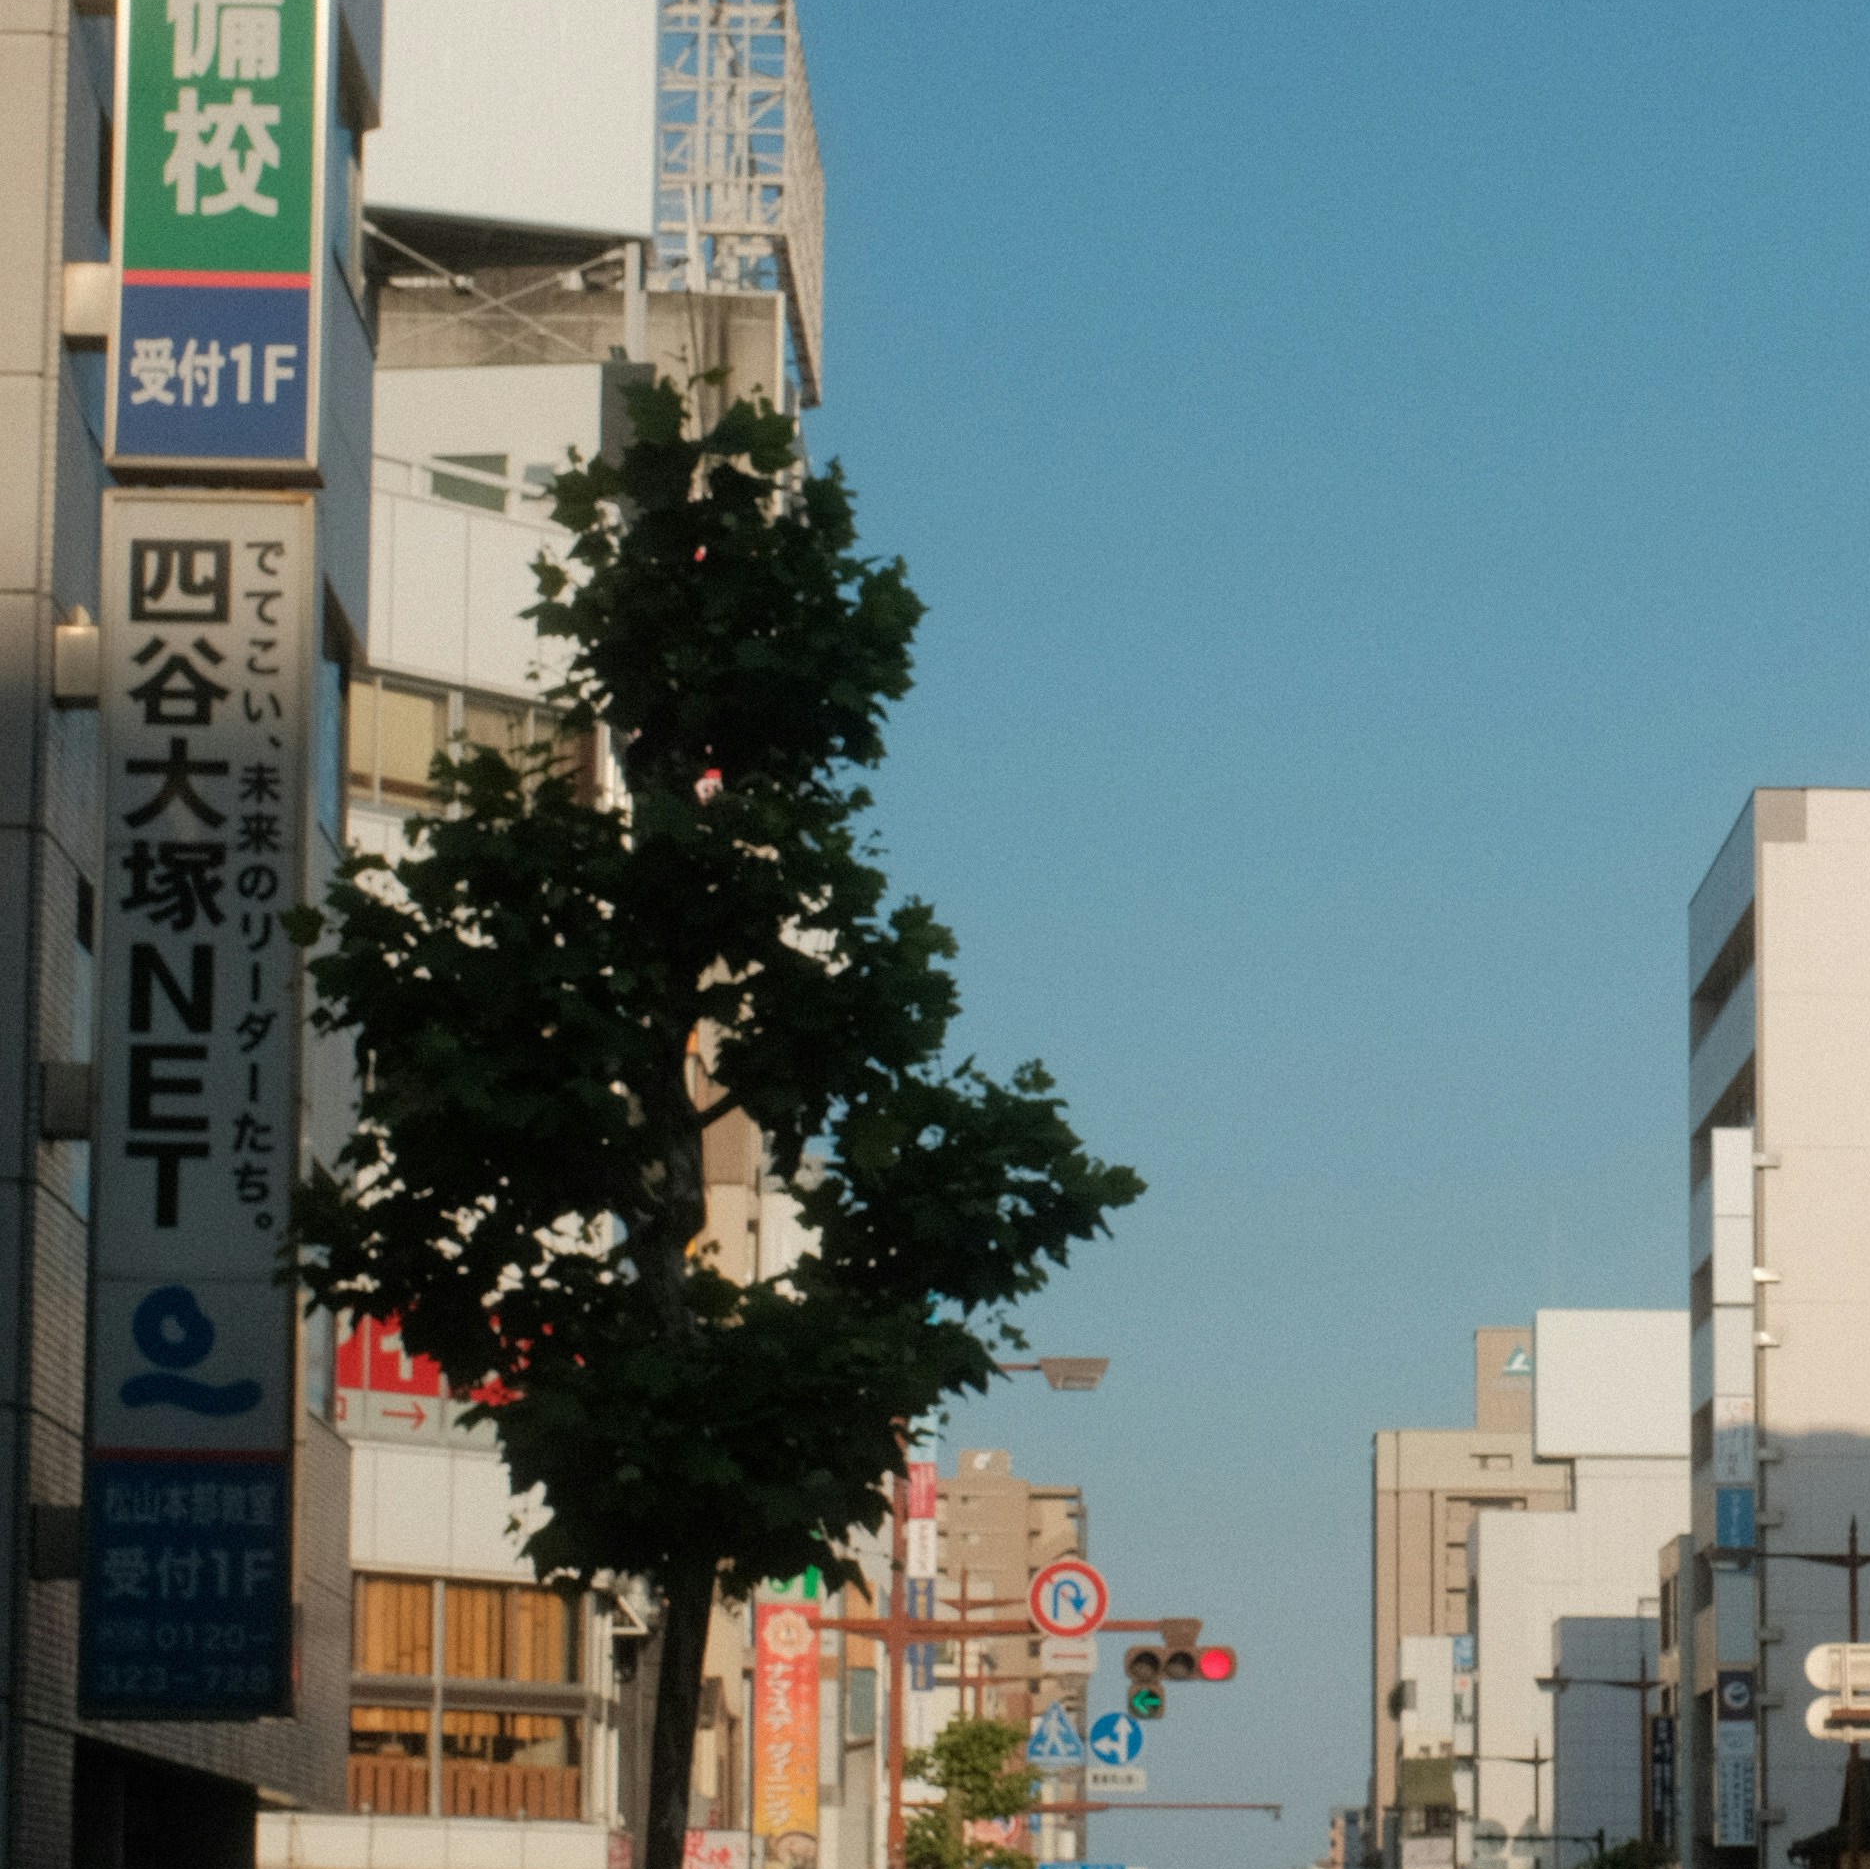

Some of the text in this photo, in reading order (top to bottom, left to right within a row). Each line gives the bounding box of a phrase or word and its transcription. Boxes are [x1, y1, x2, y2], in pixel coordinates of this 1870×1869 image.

[128, 338, 299, 408] 受付1F
[120, 538, 232, 1228] 四谷大塚NET
[230, 539, 286, 1232] でてこい、未来のリーダーたち。
[102, 1546, 276, 1600] 受付1F
